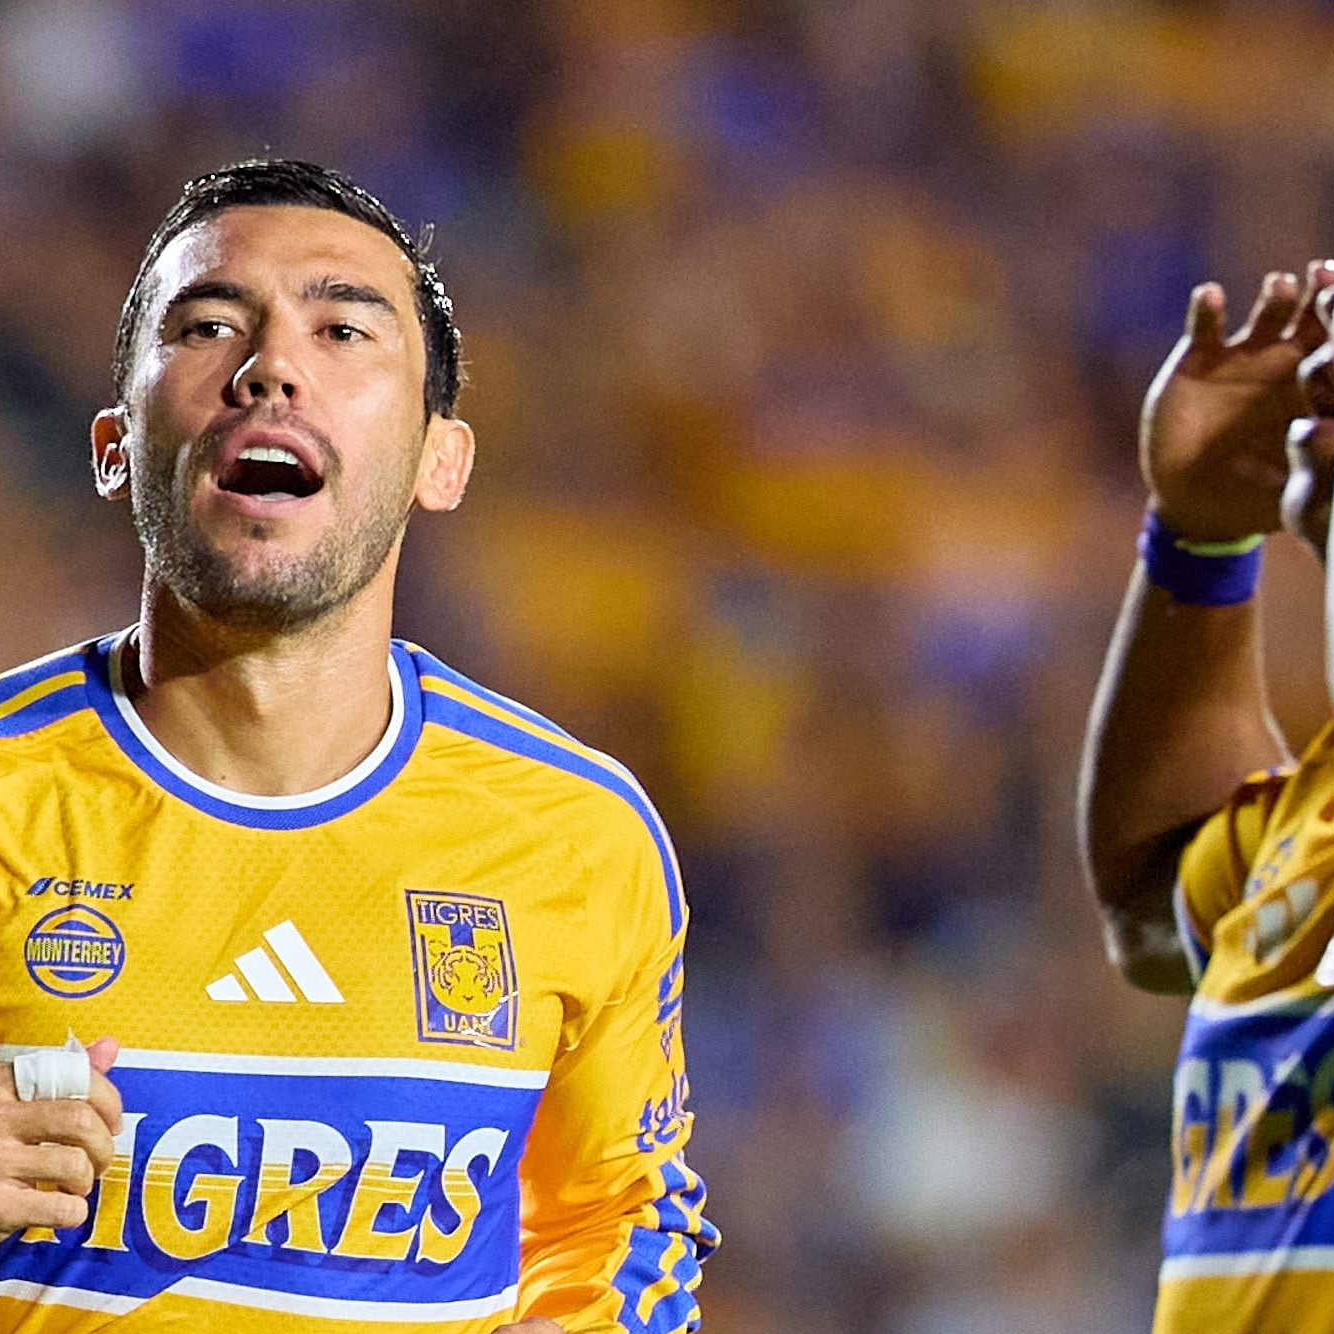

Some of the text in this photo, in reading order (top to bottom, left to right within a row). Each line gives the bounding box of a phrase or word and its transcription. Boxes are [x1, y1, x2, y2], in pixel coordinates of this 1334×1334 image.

[53, 880, 135, 900] CEMEX
[417, 900, 499, 929] TIGRES
[27, 937, 122, 965] MONTERREY
[19, 1112, 510, 1265] IGRES
